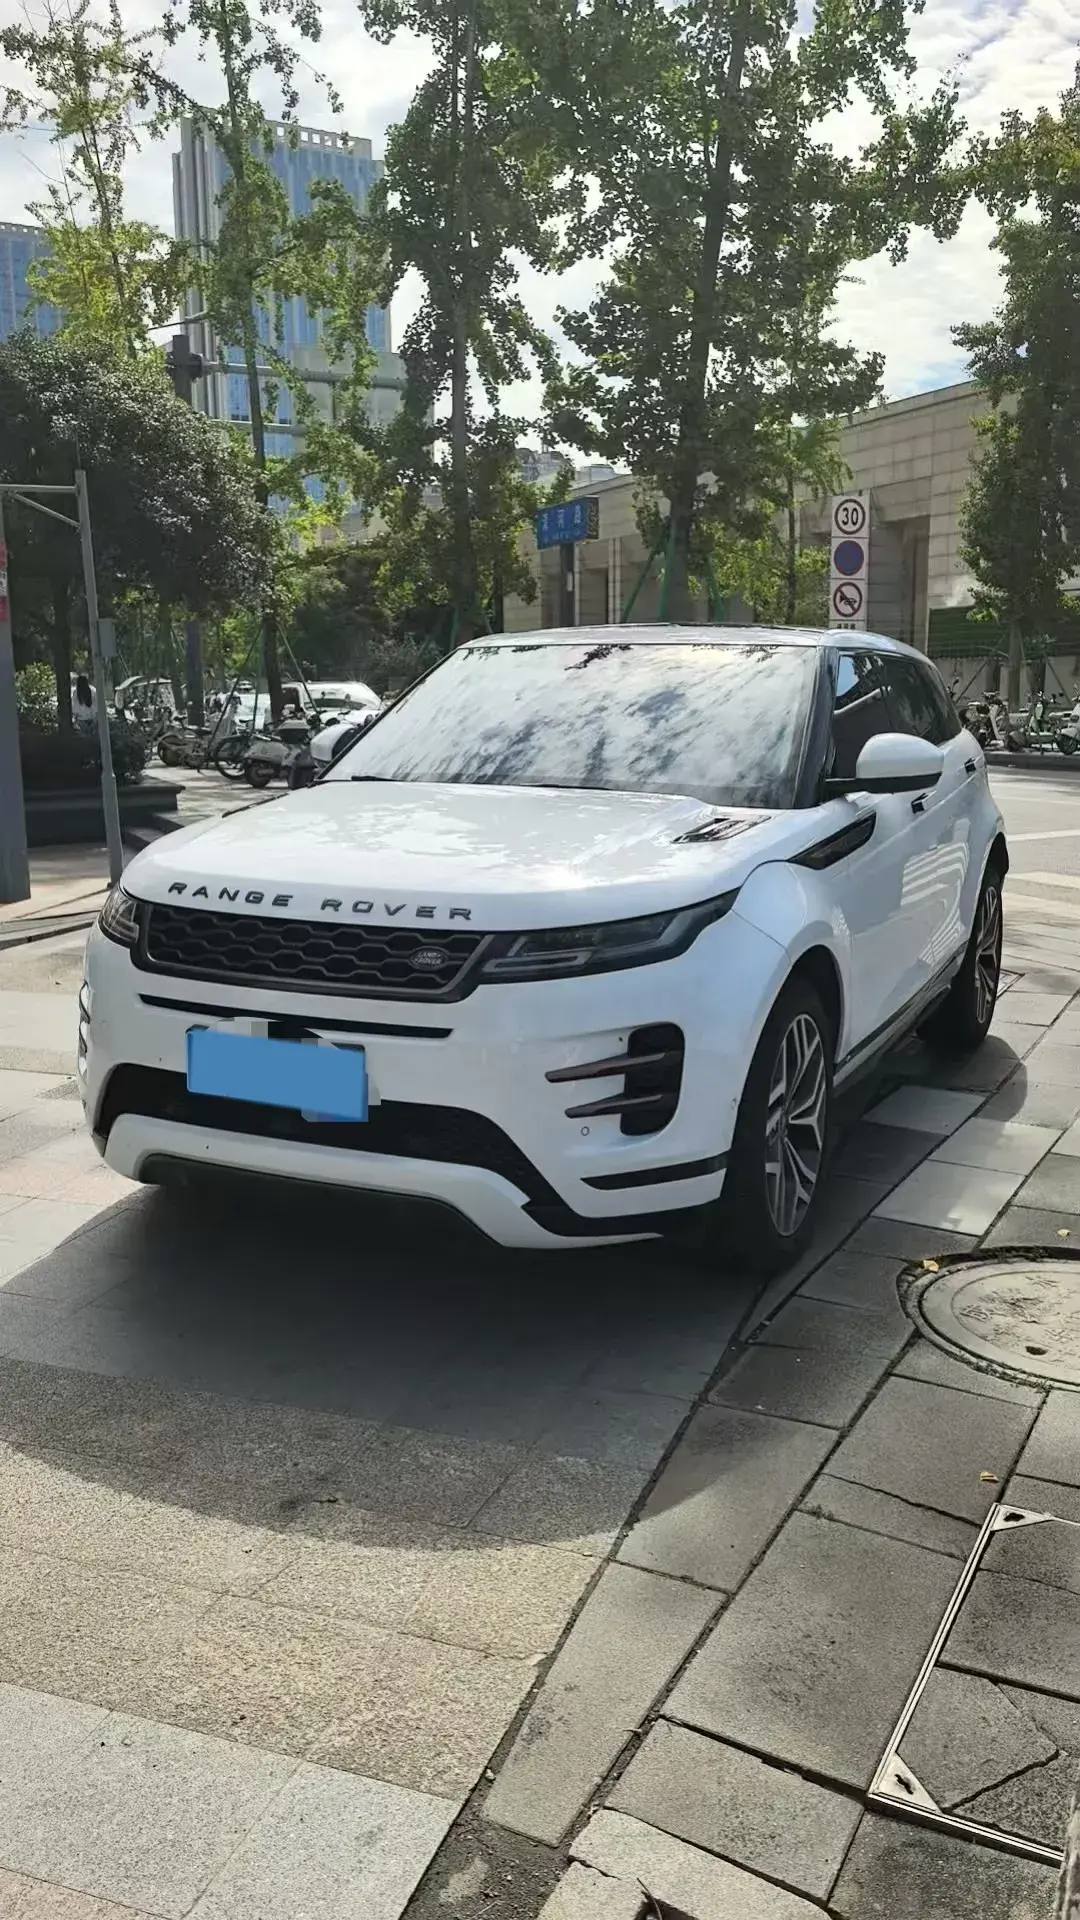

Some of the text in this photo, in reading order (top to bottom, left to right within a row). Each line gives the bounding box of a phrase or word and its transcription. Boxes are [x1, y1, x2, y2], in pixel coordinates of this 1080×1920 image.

[842, 507, 859, 526] 30
[168, 882, 472, 921] RANGE ROVER
